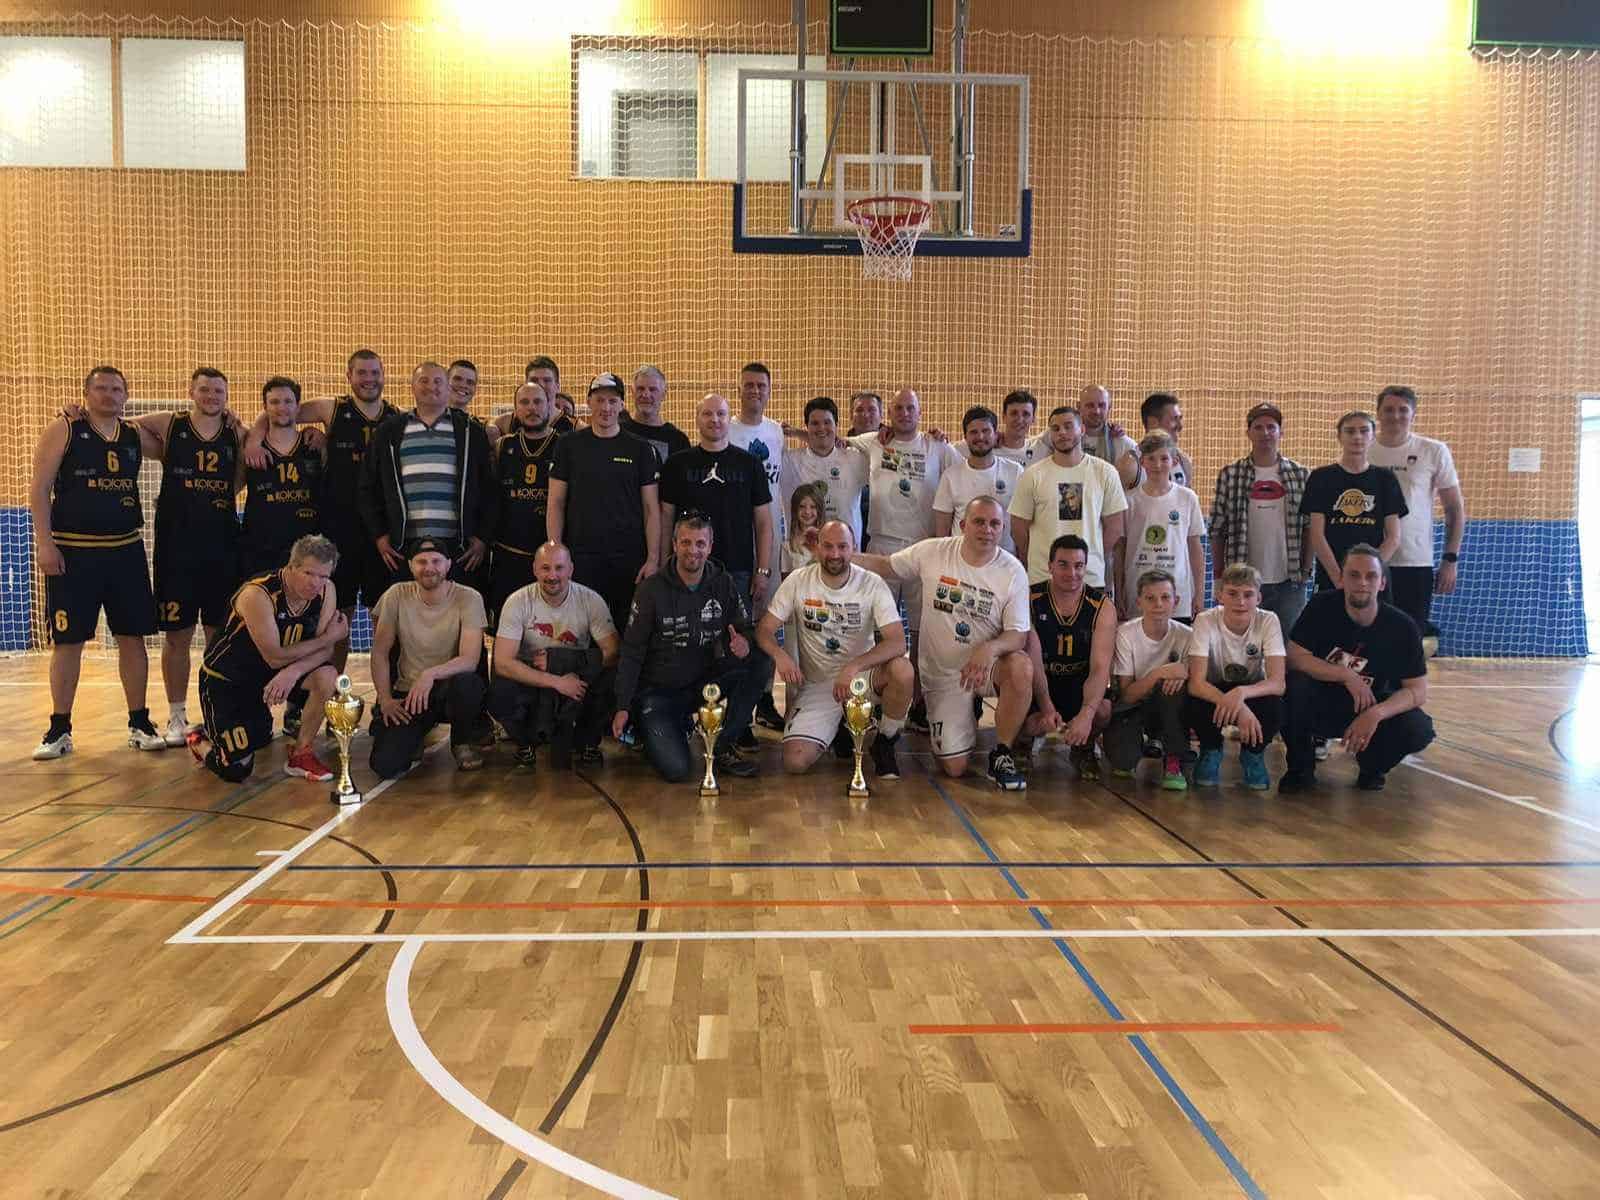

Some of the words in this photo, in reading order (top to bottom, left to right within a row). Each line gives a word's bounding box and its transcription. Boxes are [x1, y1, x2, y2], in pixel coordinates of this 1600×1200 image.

[107, 450, 120, 473] 6
[195, 450, 219, 473] 12
[277, 462, 300, 484] 14
[524, 463, 537, 484] 9
[55, 610, 68, 632] 6
[158, 601, 181, 622] 12
[1057, 633, 1073, 657] 11
[221, 726, 249, 751] 10
